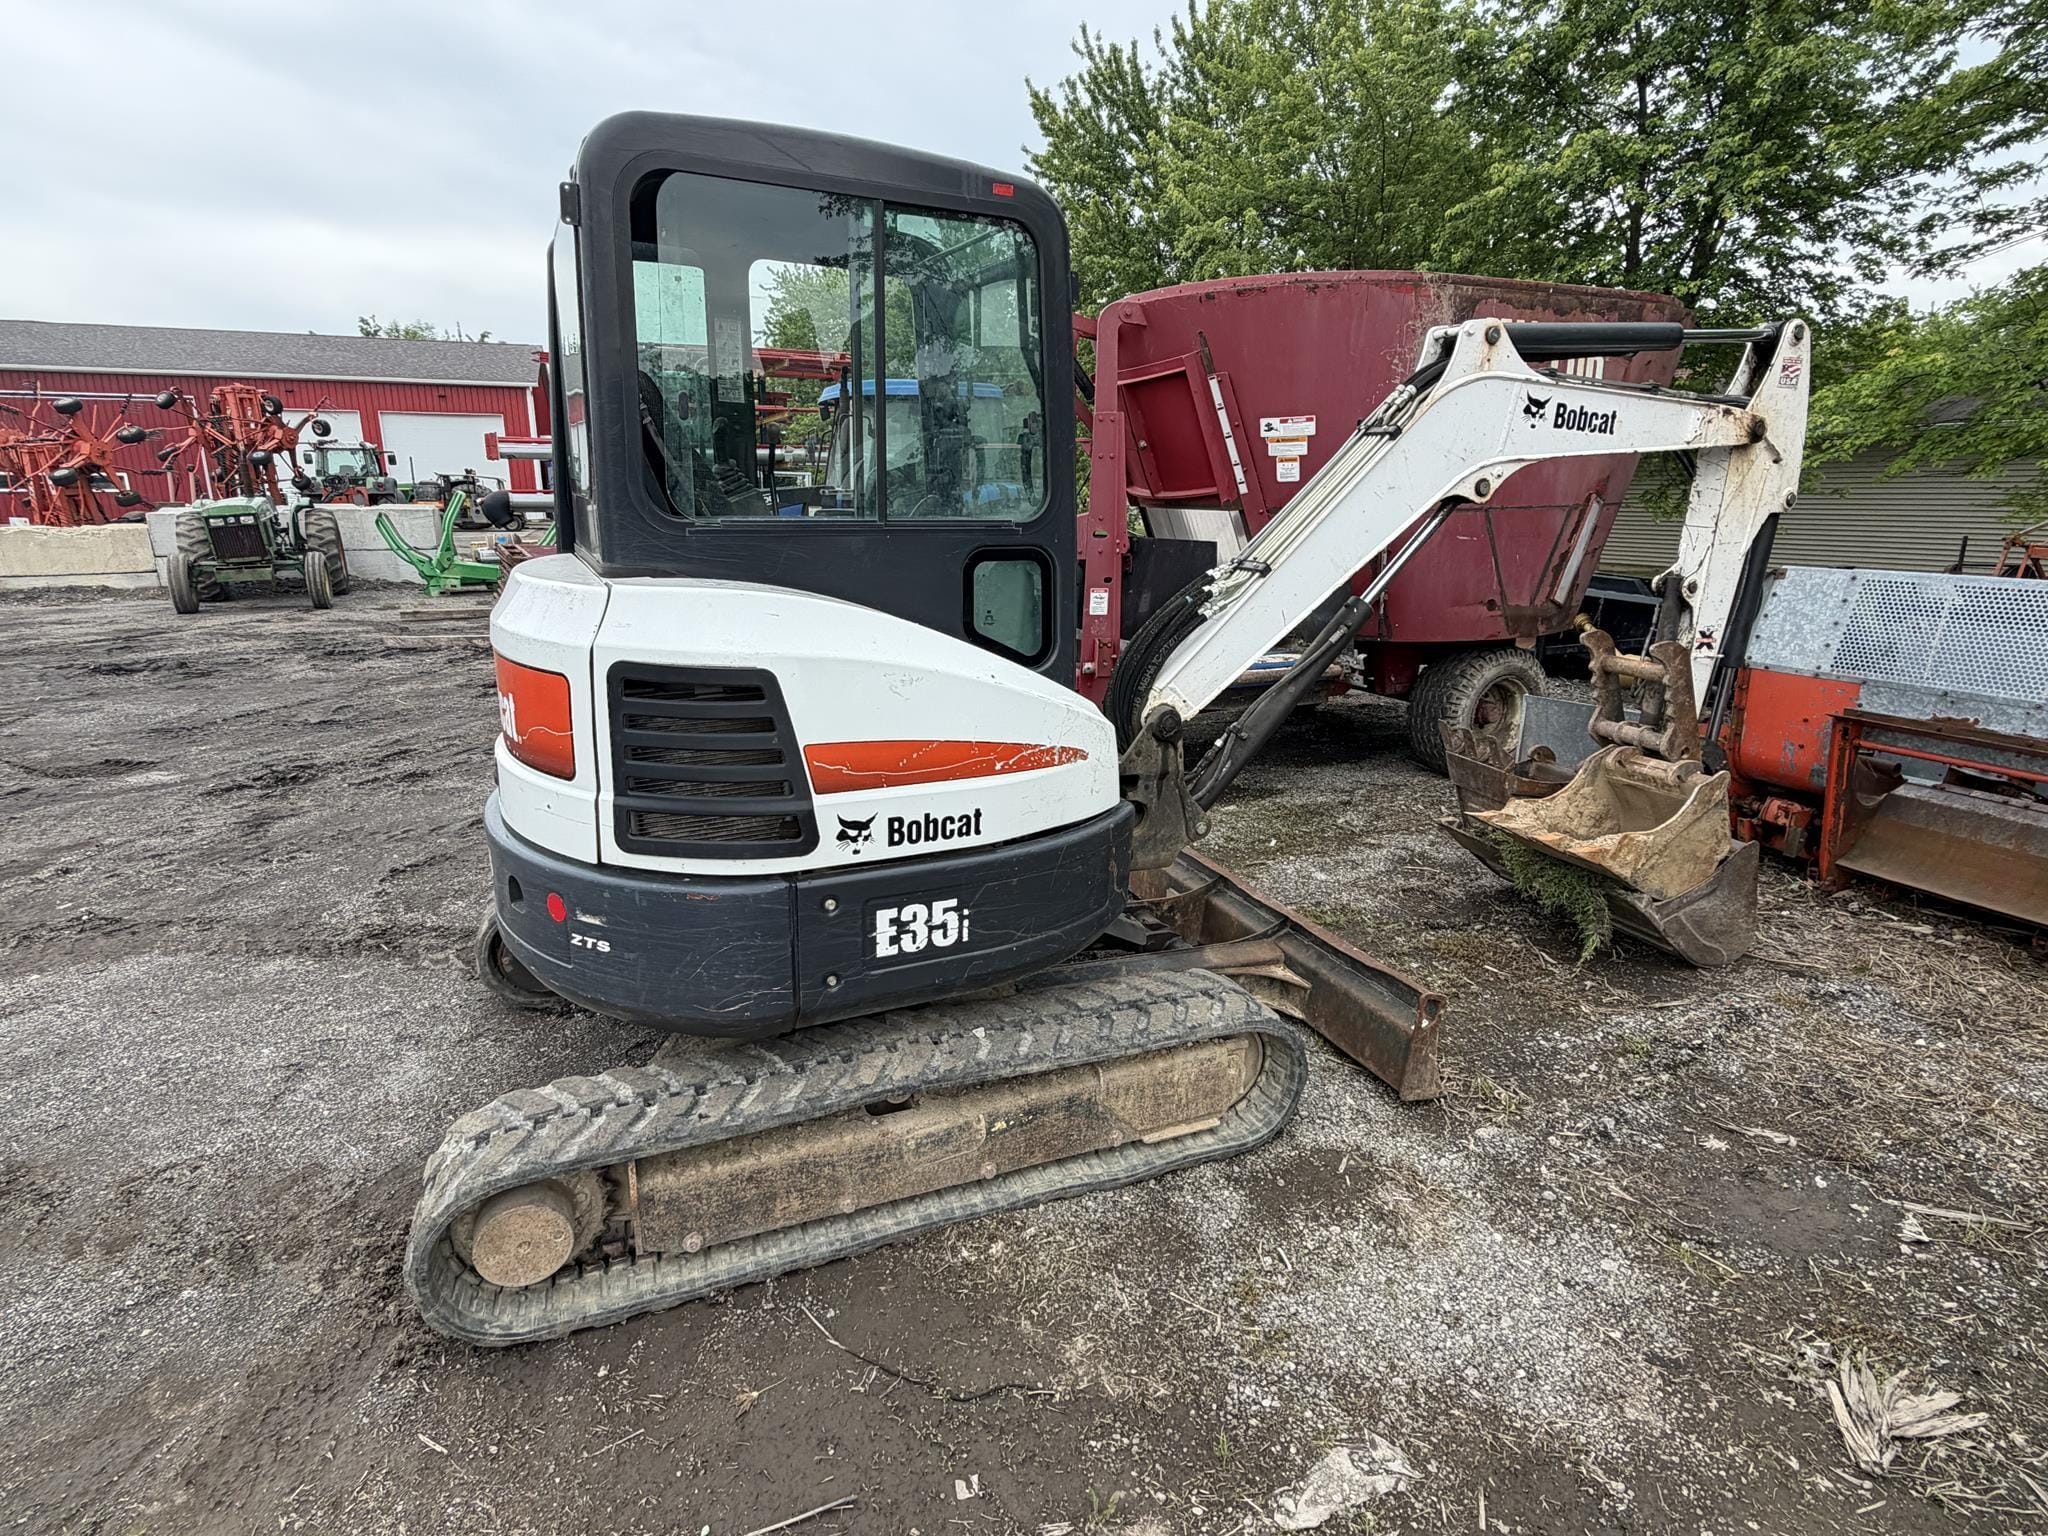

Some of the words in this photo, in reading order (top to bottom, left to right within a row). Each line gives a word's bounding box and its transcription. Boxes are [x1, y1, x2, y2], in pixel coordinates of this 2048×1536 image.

[1553, 402, 1618, 435] Bobcat
[887, 808, 983, 848] Bobcat
[570, 932, 611, 953] ZTS
[876, 898, 970, 958] E35i
